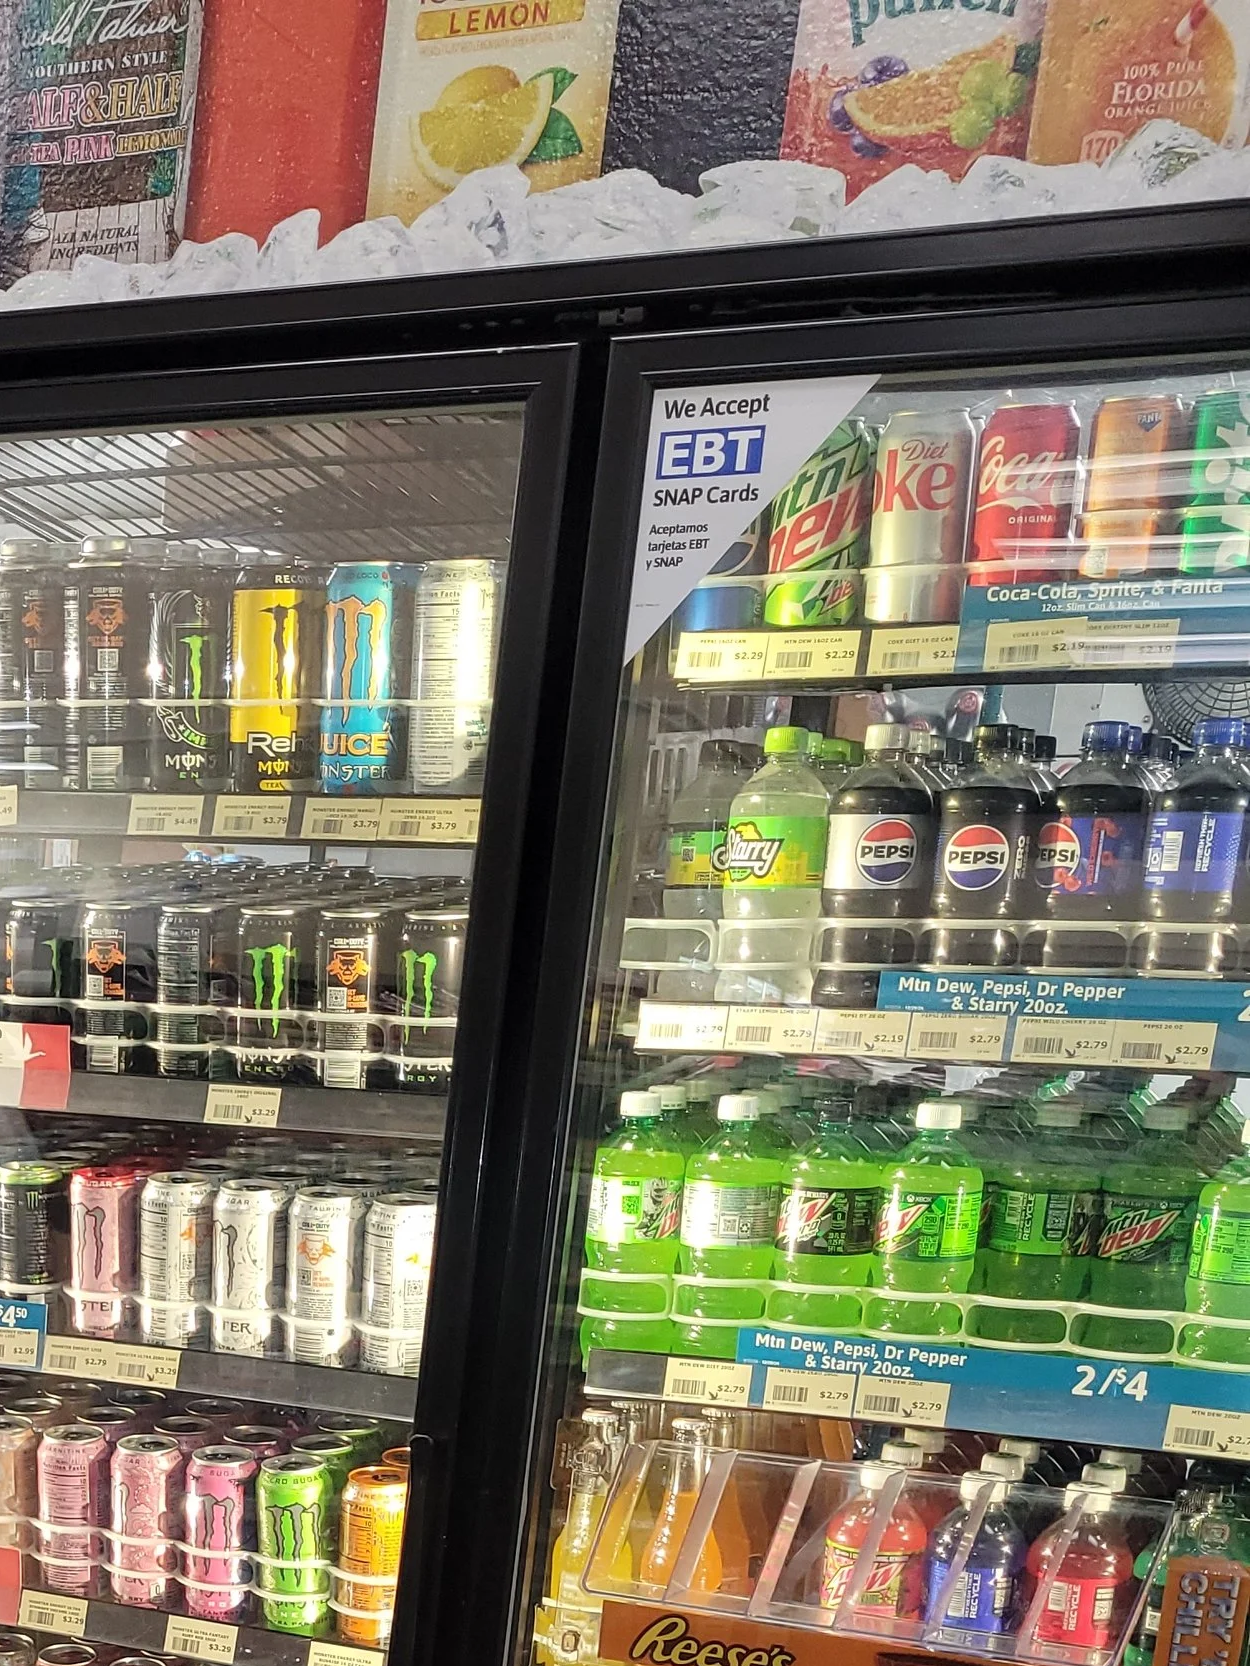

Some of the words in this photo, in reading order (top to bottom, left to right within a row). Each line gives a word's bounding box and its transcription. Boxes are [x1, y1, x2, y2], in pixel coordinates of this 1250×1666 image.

[450, 1, 549, 34] LEMON
[122, 51, 167, 69] STYLE
[1124, 61, 1159, 79] 100%
[1167, 60, 1204, 74] PURE
[1112, 80, 1206, 103] FLORIDA
[1104, 102, 1165, 119] ORANGE
[64, 131, 114, 163] PINK
[80, 225, 139, 243] NATURAL
[664, 400, 696, 419] We
[700, 394, 770, 419] Accept
[660, 429, 762, 477] EBT
[902, 440, 949, 461] Diet
[653, 487, 703, 507] SNAP
[707, 483, 759, 504] Cards
[649, 522, 709, 538] Aceptamos
[647, 540, 687, 554] tarjetas
[689, 539, 710, 550] EBT
[654, 557, 683, 568] SNAP
[986, 583, 1082, 602] Coca-Cola,
[1088, 581, 1145, 600] Sprite,
[1148, 580, 1165, 595] &
[1172, 578, 1223, 595] Fanta
[825, 650, 855, 660] $2.29
[1052, 640, 1085, 652] $2.19
[711, 824, 781, 877] Starry
[860, 845, 915, 859] PEPSI
[1202, 817, 1216, 872] RECYCLE
[948, 850, 1005, 865] PEPSI
[898, 976, 931, 992] Mtn
[936, 978, 977, 996] Dew,
[982, 979, 1031, 998] Pepsi,
[1037, 981, 1057, 996] Dr
[1062, 982, 1125, 1001] Pepper
[951, 997, 963, 1010] &
[968, 997, 1019, 1015] Starry
[1024, 999, 1068, 1014] 20oz.
[1175, 1046, 1208, 1055] $2.79
[755, 1333, 785, 1349] Mtn
[791, 1336, 828, 1357] Dew,
[833, 1340, 879, 1360] Pepsi,
[884, 1345, 904, 1360] Dr
[909, 1346, 967, 1367] Pepper
[805, 1354, 816, 1368] &
[820, 1355, 867, 1375] Starry
[871, 1361, 914, 1378] 20oz.
[912, 1401, 942, 1412] $2.79
[1068, 1584, 1081, 1632] RECYCLE
[1207, 1577, 1240, 1643] TRY
